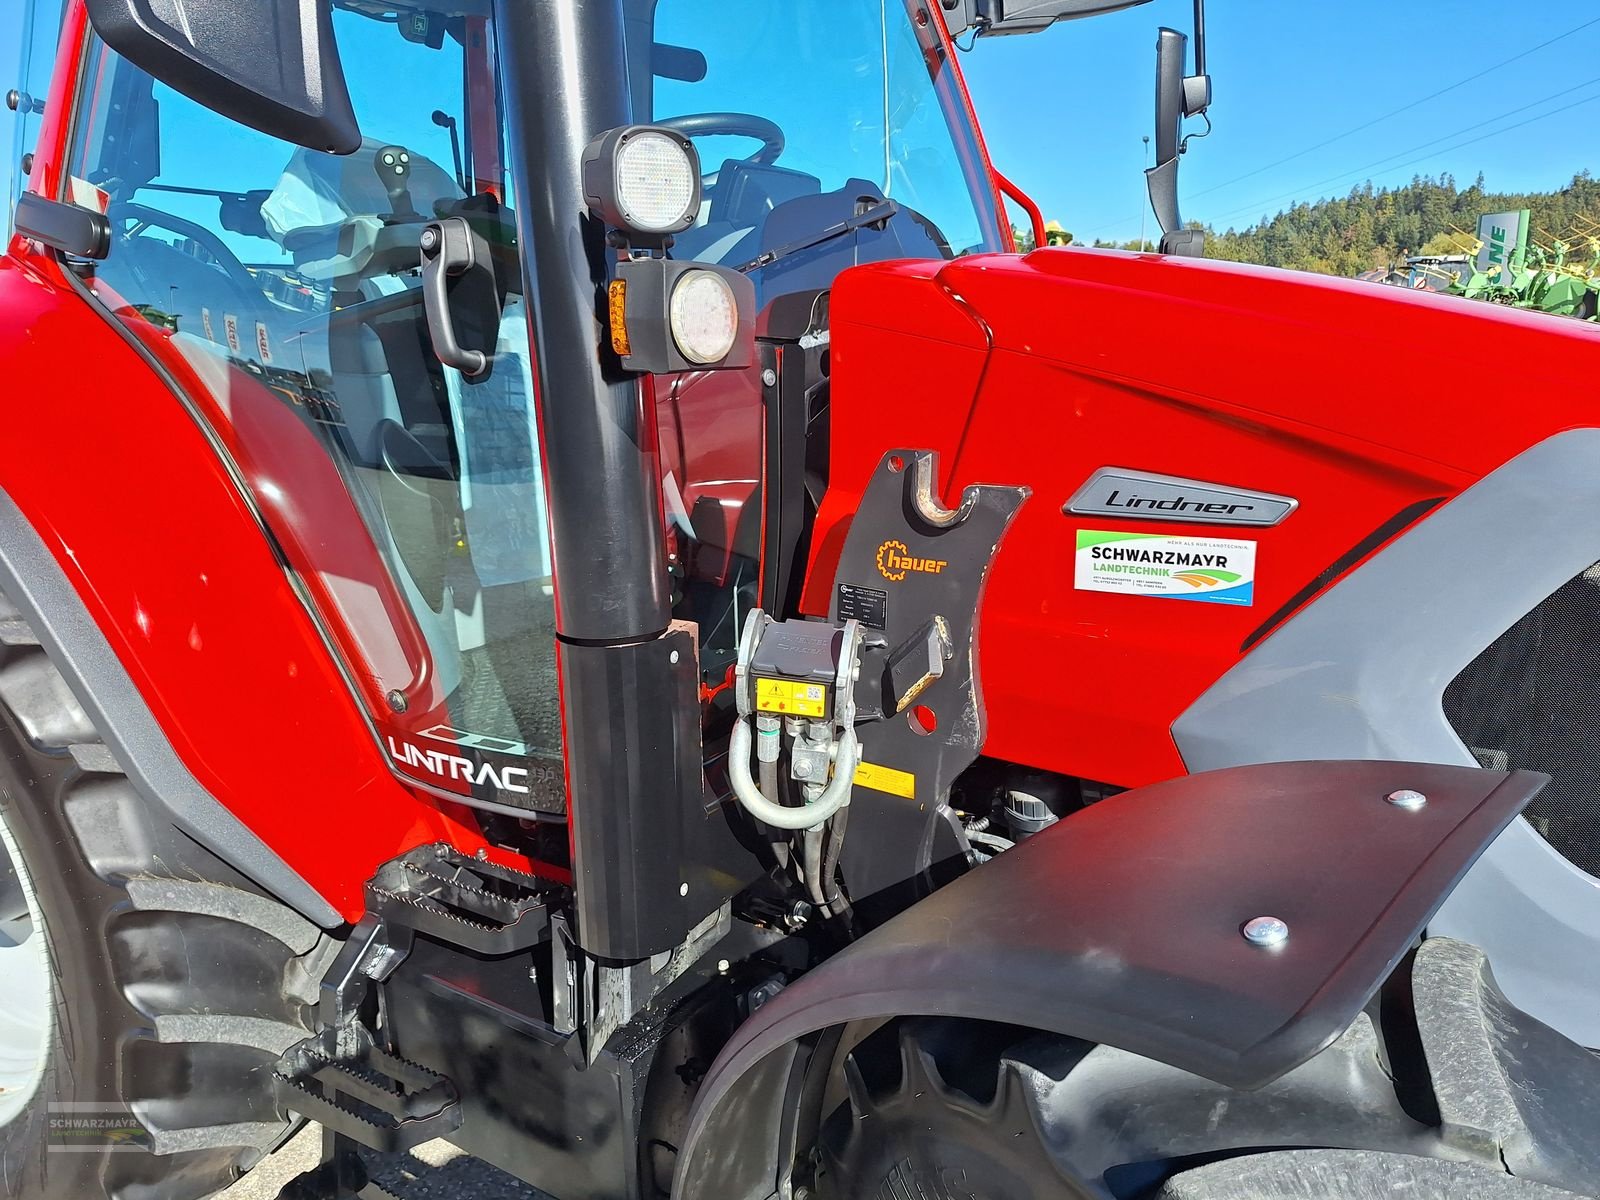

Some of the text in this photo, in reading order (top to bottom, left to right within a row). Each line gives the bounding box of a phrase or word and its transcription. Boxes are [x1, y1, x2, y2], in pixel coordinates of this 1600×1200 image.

[1105, 490, 1254, 514] Lindner
[887, 549, 948, 573] hauer
[1091, 546, 1228, 568] SCHWARZMAYR
[1093, 563, 1170, 577] LANDTECHNIK
[388, 736, 529, 793] LINTRAC
